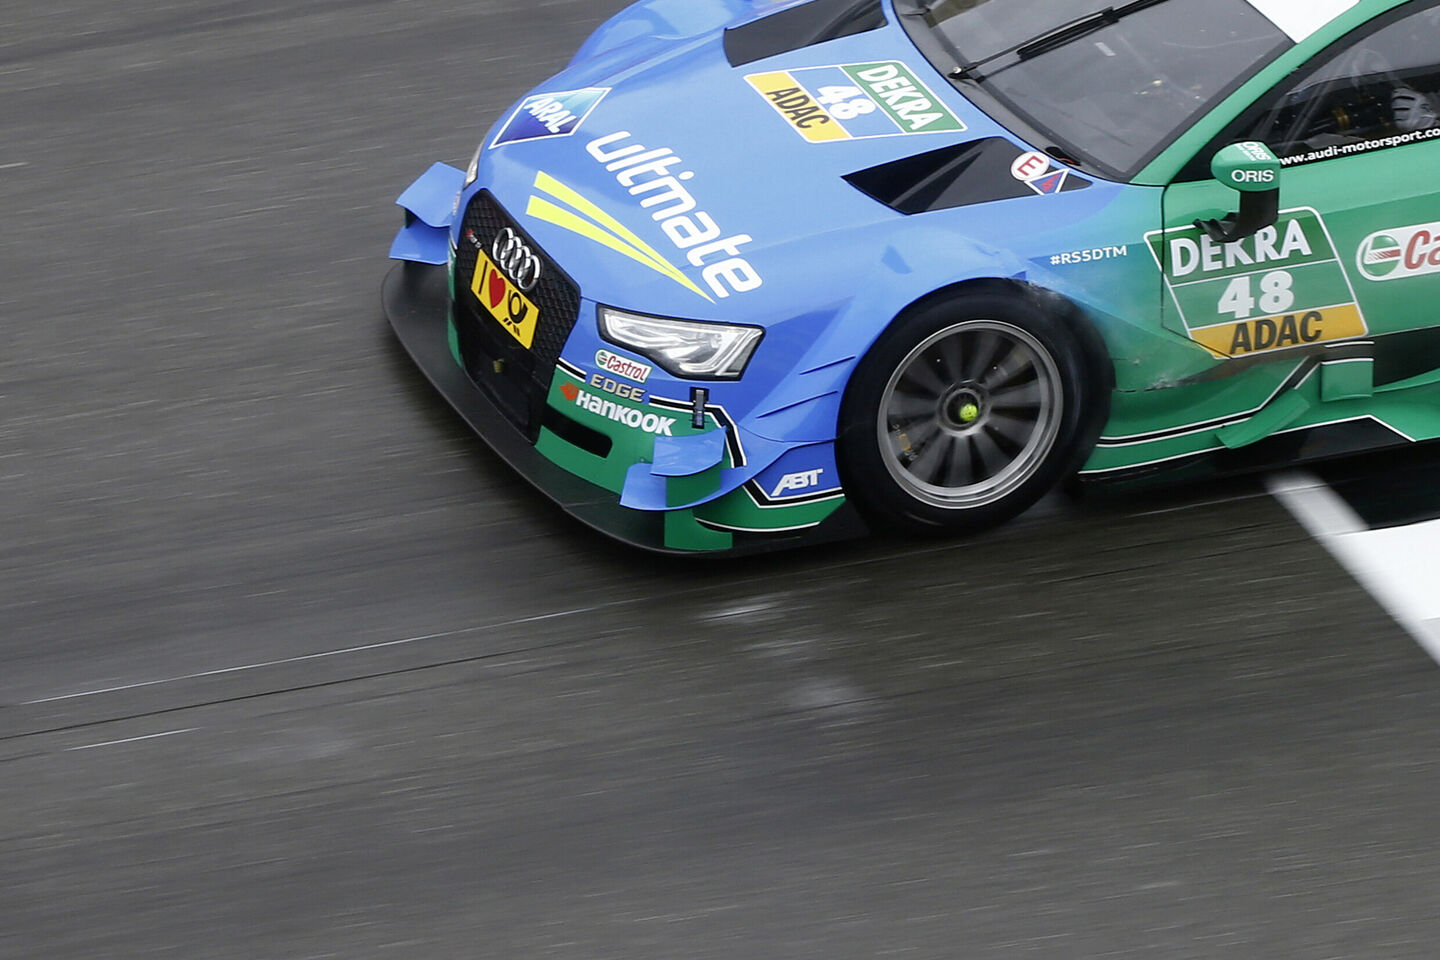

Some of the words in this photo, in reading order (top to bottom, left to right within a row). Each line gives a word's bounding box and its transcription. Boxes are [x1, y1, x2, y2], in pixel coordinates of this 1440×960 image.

[524, 96, 577, 134] ARAL
[766, 87, 830, 129] ADAC
[816, 85, 876, 120] 48
[857, 64, 943, 131] DEKRA
[1231, 169, 1274, 183] ORIS
[585, 131, 763, 298] ultimate
[1050, 245, 1128, 266] #RS5DTM
[1169, 218, 1313, 277] DEKRA
[1217, 270, 1295, 319] 48
[1229, 311, 1323, 355] ADAC
[590, 374, 648, 402] EDGE
[607, 355, 649, 383] Castrol
[770, 468, 824, 497] ABT
